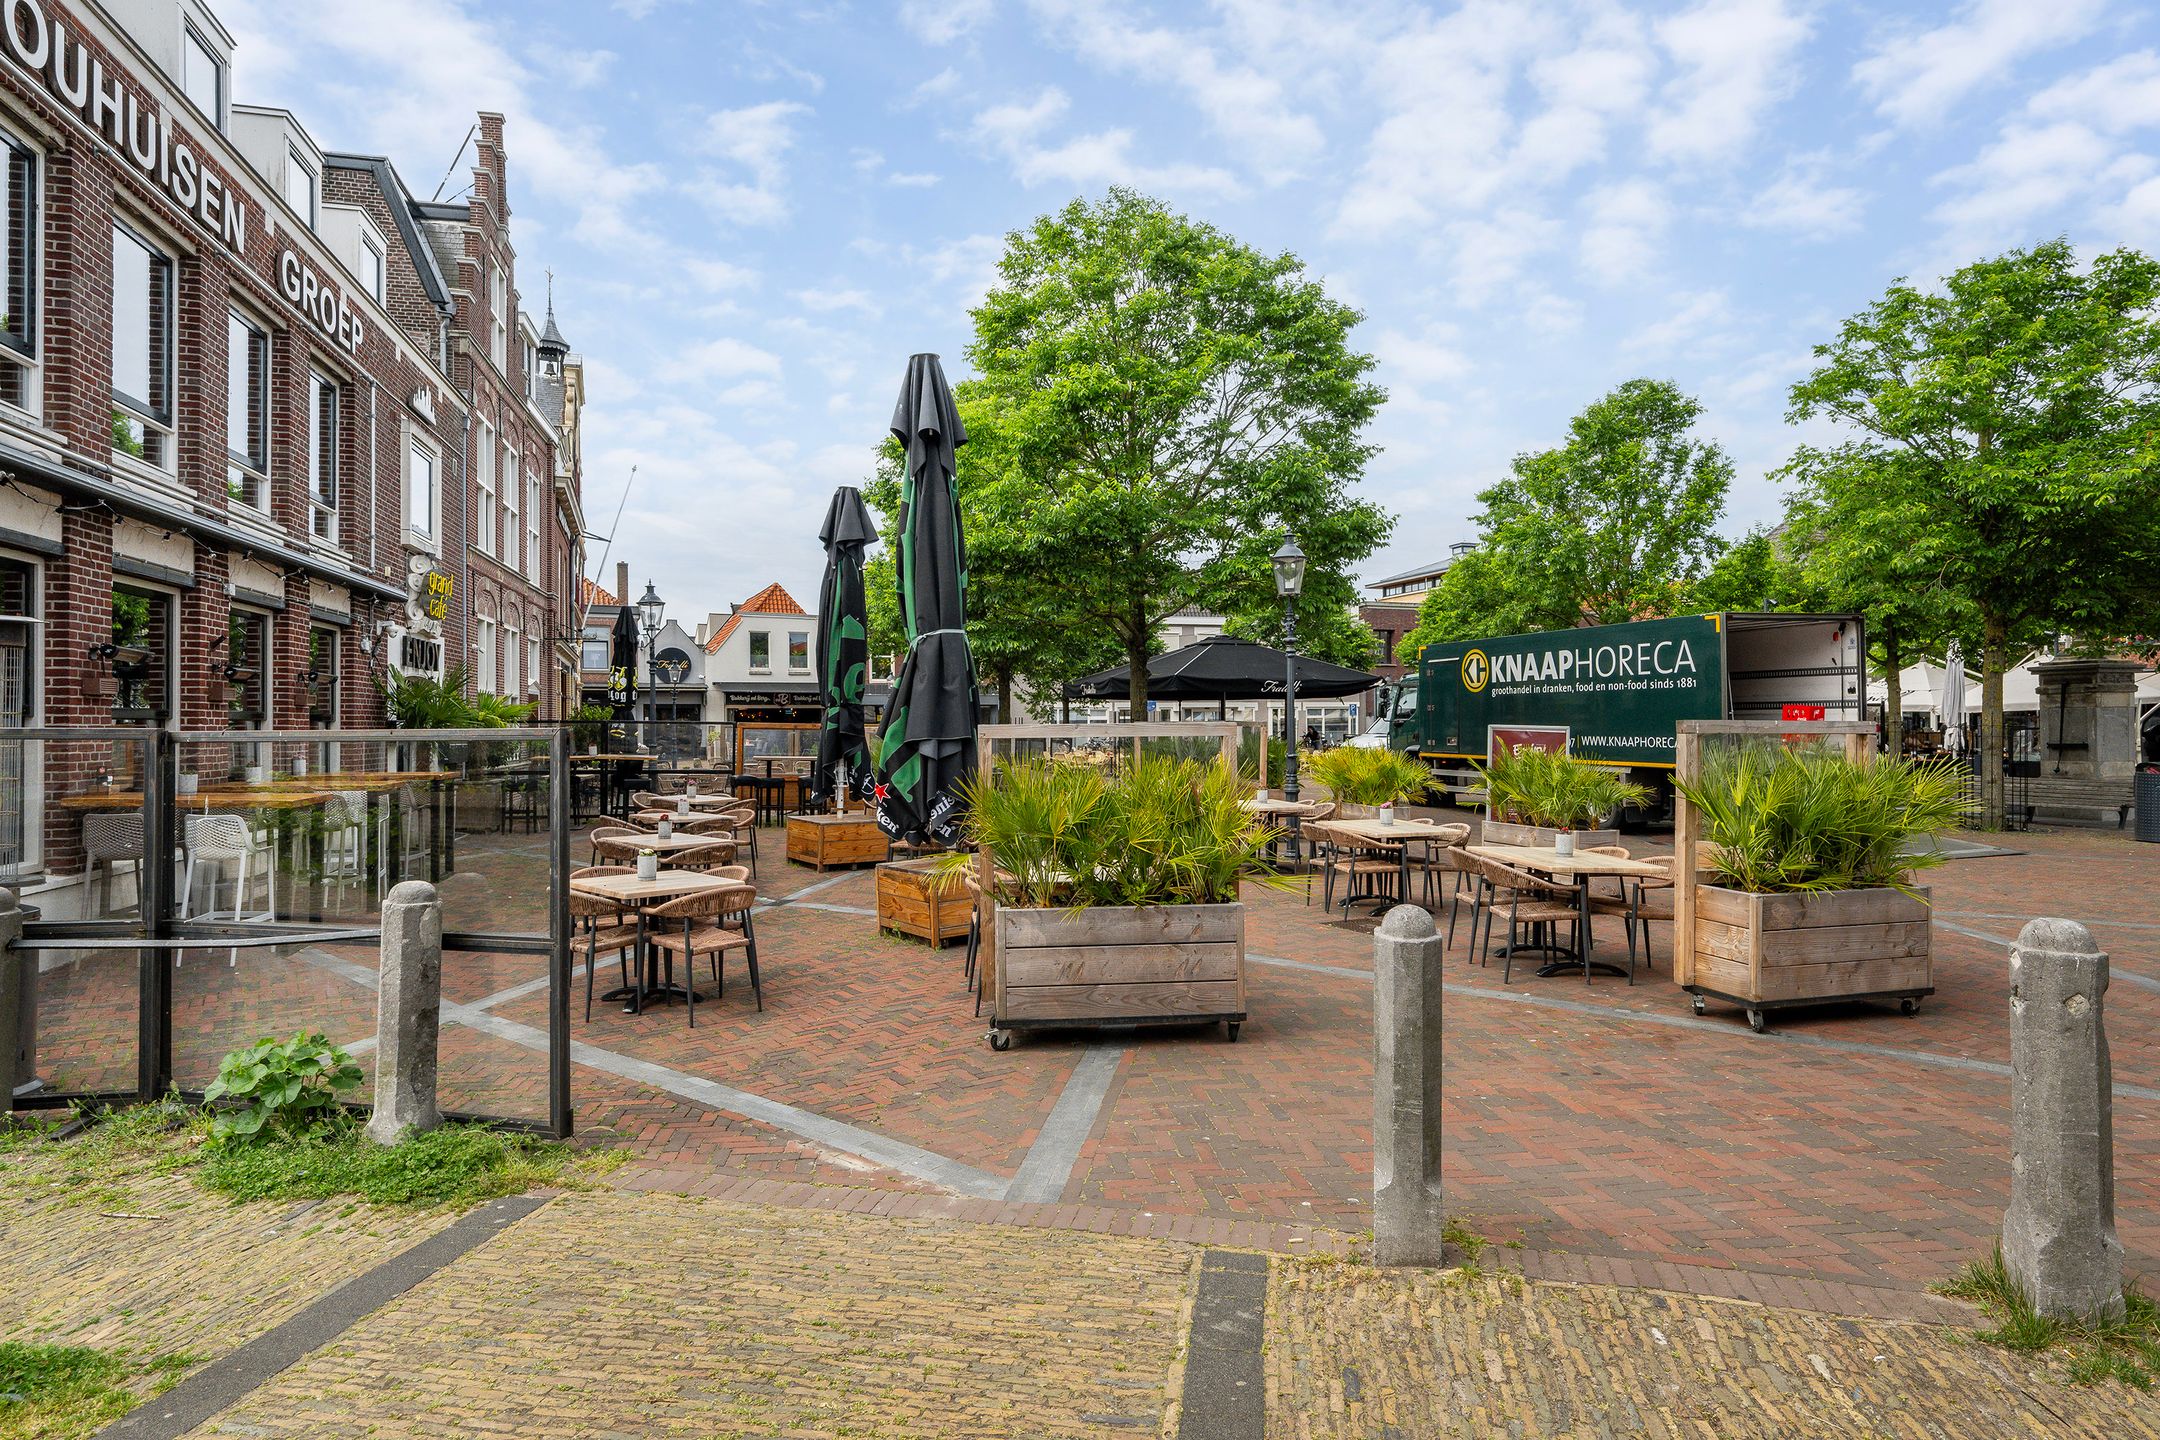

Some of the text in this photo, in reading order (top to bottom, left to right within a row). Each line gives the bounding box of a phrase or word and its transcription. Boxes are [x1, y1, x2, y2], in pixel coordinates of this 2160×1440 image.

[3, 0, 363, 355] OUHUISEN GROEP
[429, 571, 454, 599] grand
[403, 636, 441, 671] ENJOY
[1491, 639, 1697, 683] KNAAPHORECA
[1491, 676, 1697, 698] groothandel in dranken, food en non-food sinds 1881
